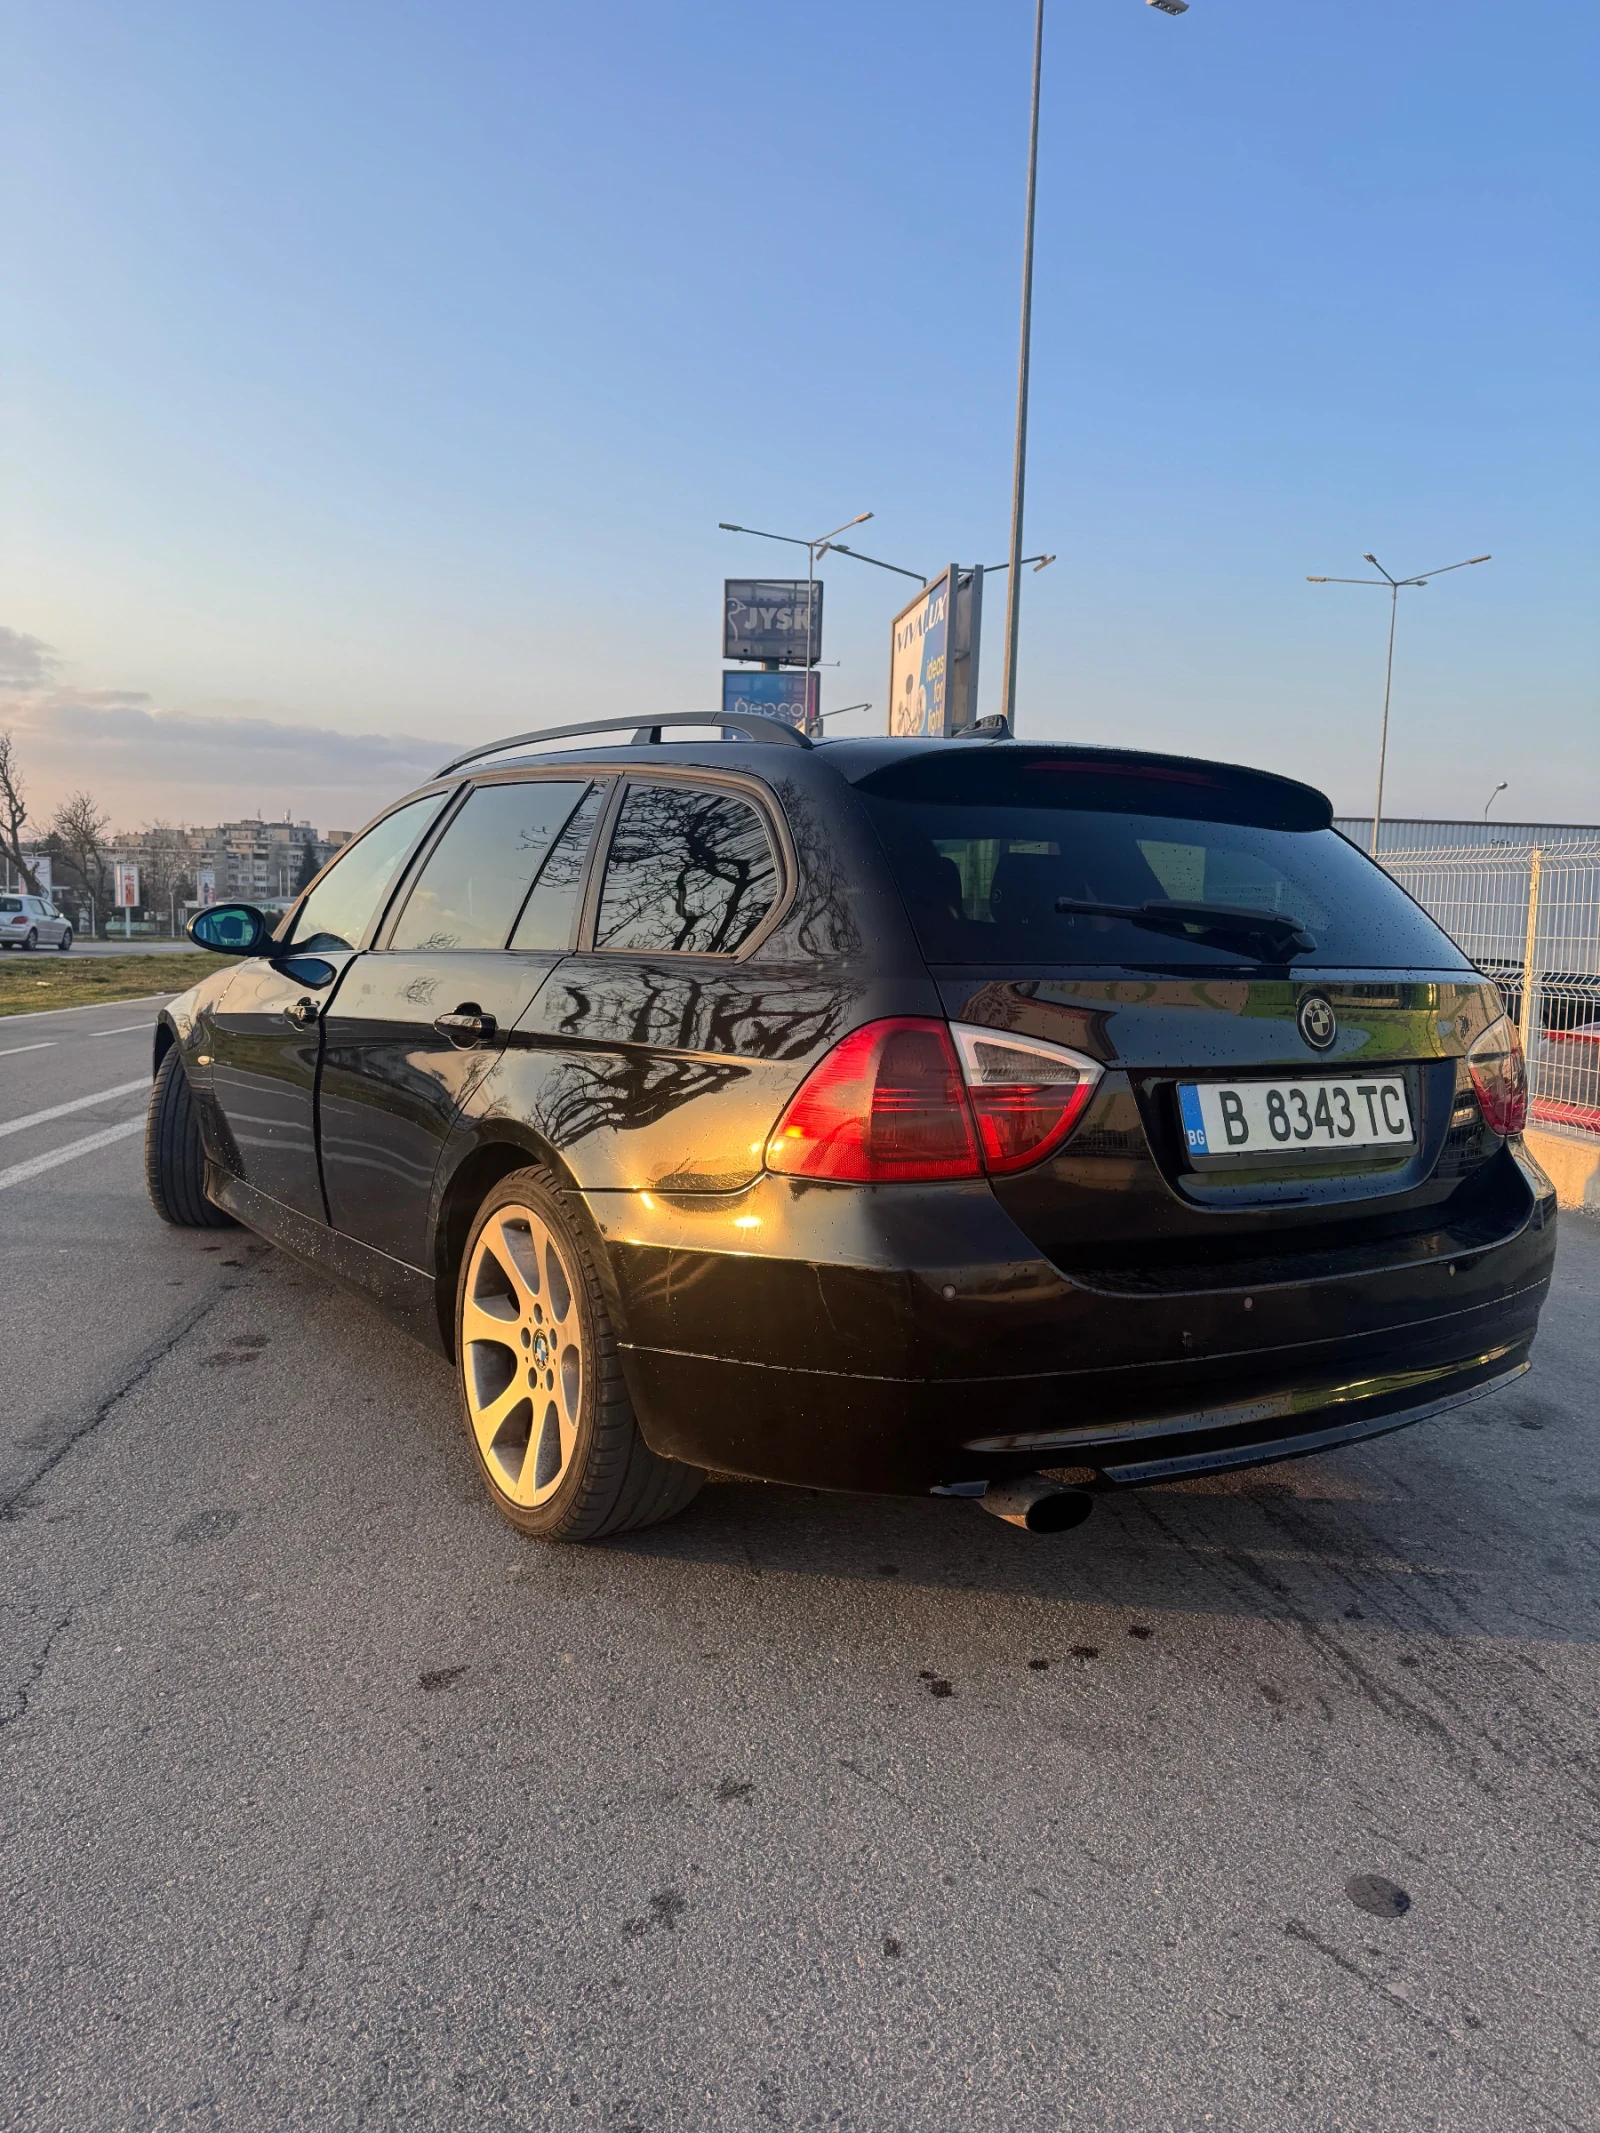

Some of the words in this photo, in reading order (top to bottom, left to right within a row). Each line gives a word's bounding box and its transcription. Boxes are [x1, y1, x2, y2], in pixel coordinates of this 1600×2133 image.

[744, 607, 814, 630] JYSK
[897, 592, 947, 654] VIVALUX
[1219, 1090, 1249, 1146] B
[1266, 1086, 1356, 1143] 8343
[1356, 1085, 1405, 1137] TC
[1188, 1129, 1206, 1146] BG
